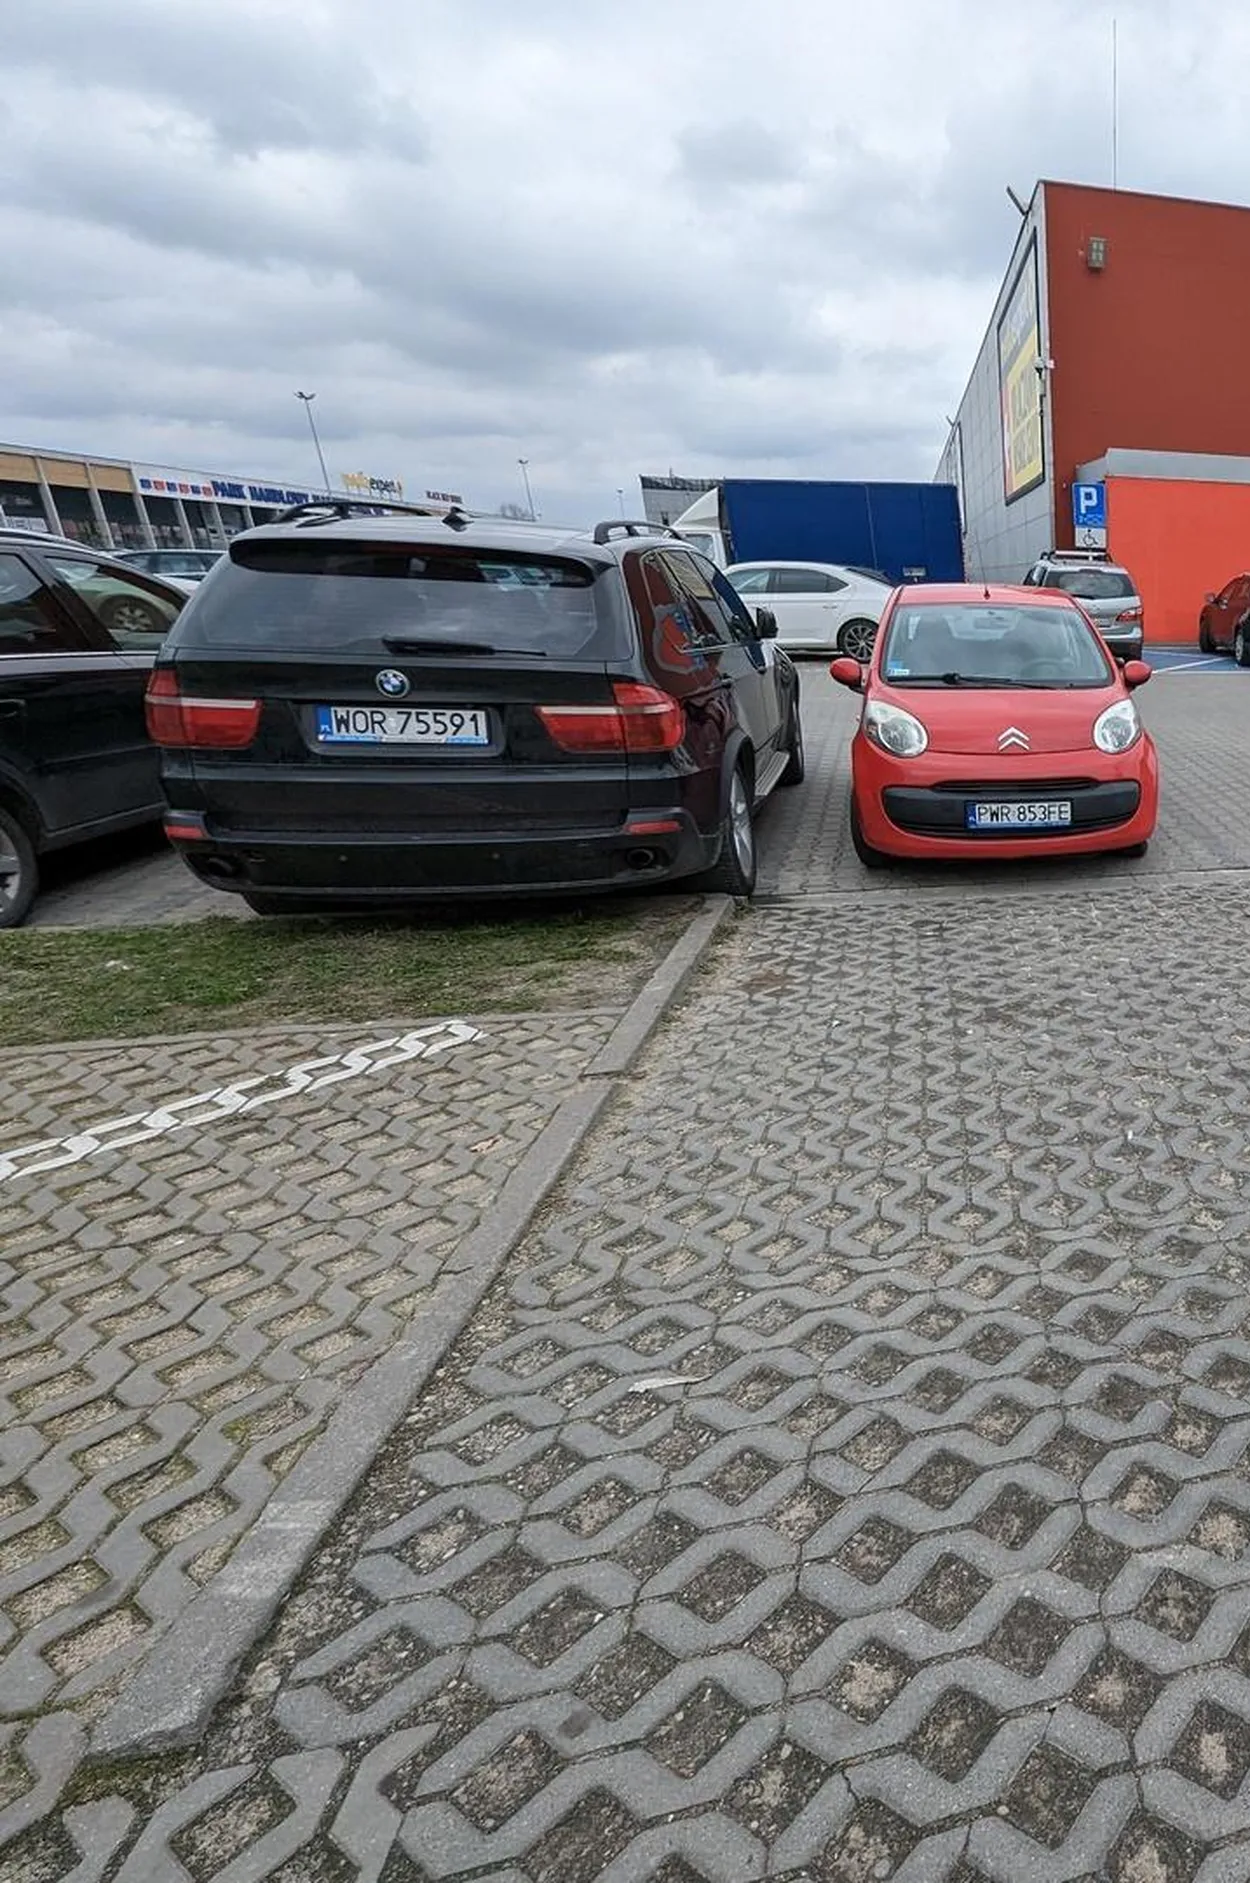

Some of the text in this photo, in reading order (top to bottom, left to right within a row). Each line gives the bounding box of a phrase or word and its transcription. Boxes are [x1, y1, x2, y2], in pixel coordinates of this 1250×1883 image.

[1080, 486, 1097, 514] P
[333, 708, 481, 737] WOR 75591
[977, 803, 1069, 823] PWR 853FE
